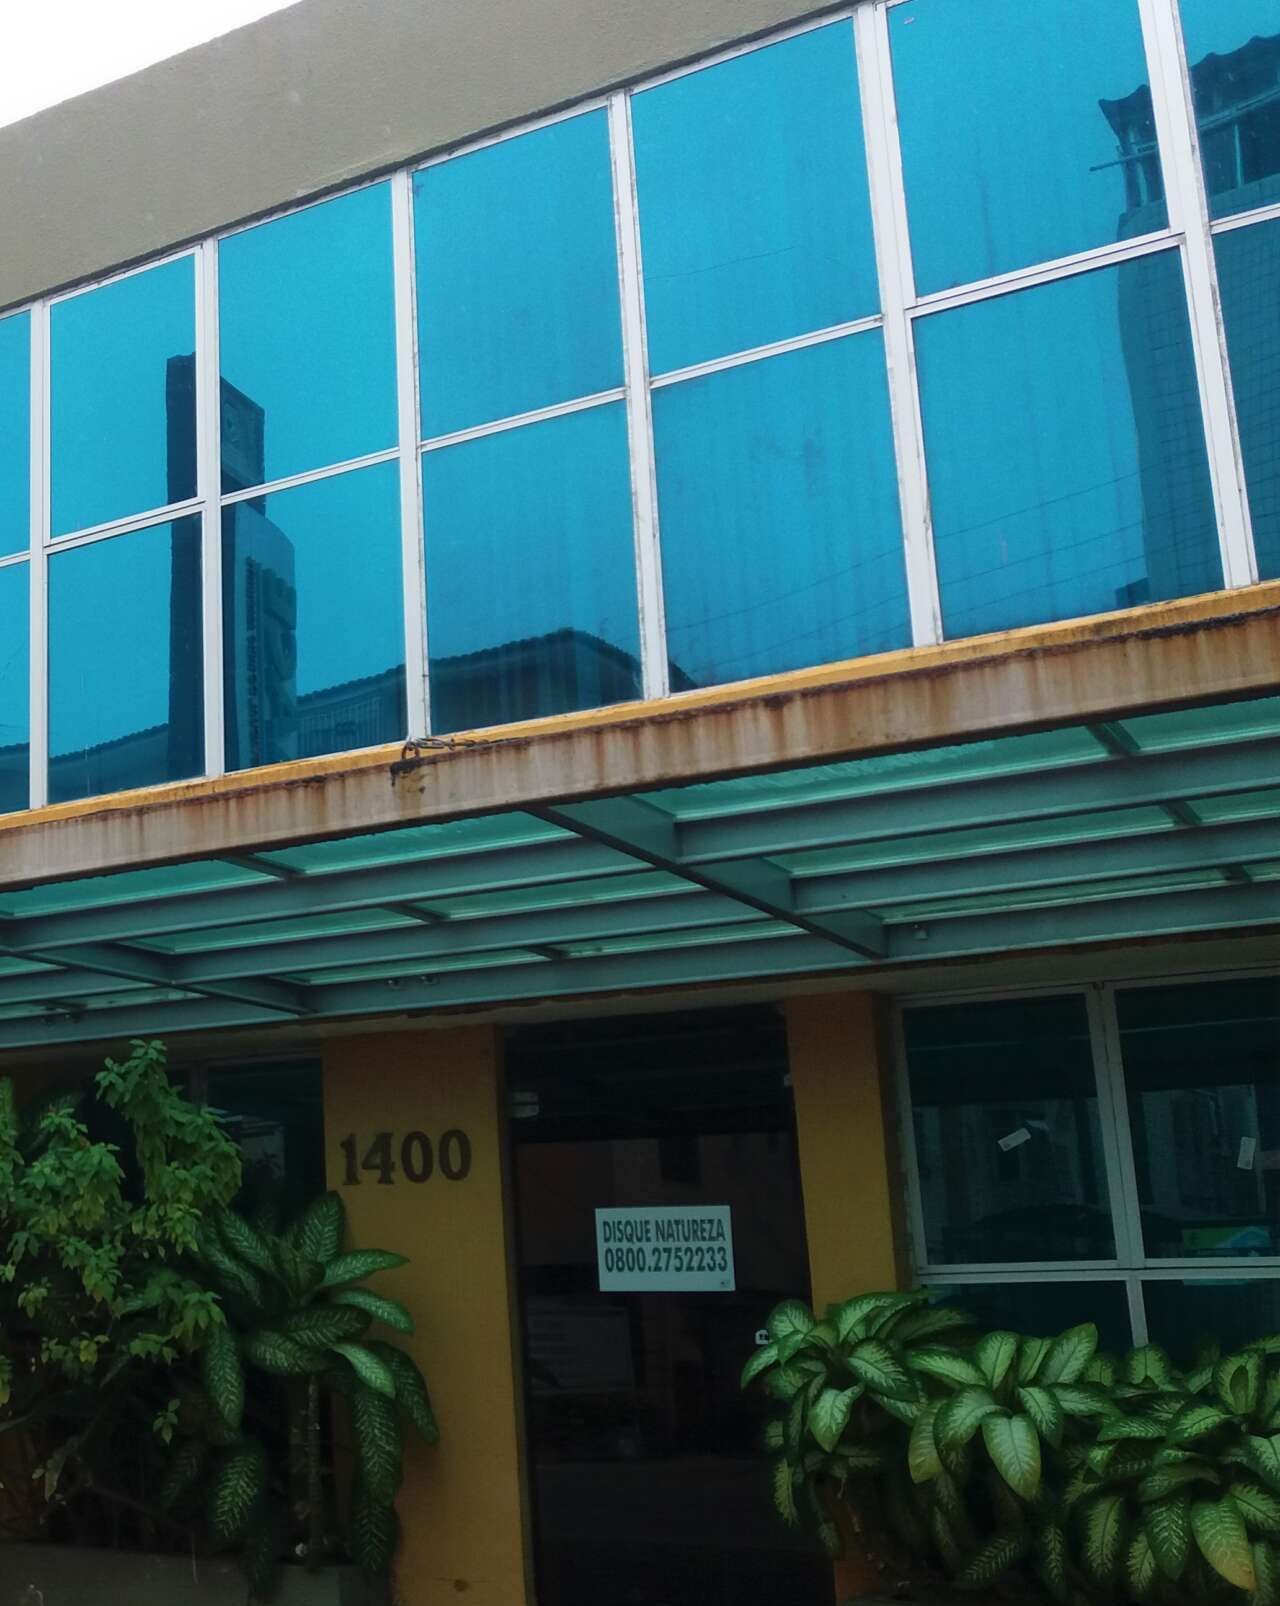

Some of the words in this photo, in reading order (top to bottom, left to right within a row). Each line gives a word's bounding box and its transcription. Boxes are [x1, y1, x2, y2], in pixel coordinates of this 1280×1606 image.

[340, 1129, 472, 1185] 1400
[602, 1219, 652, 1244] DISQUE
[655, 1218, 726, 1242] NATUREZA
[605, 1246, 728, 1272] 0800.2752233
